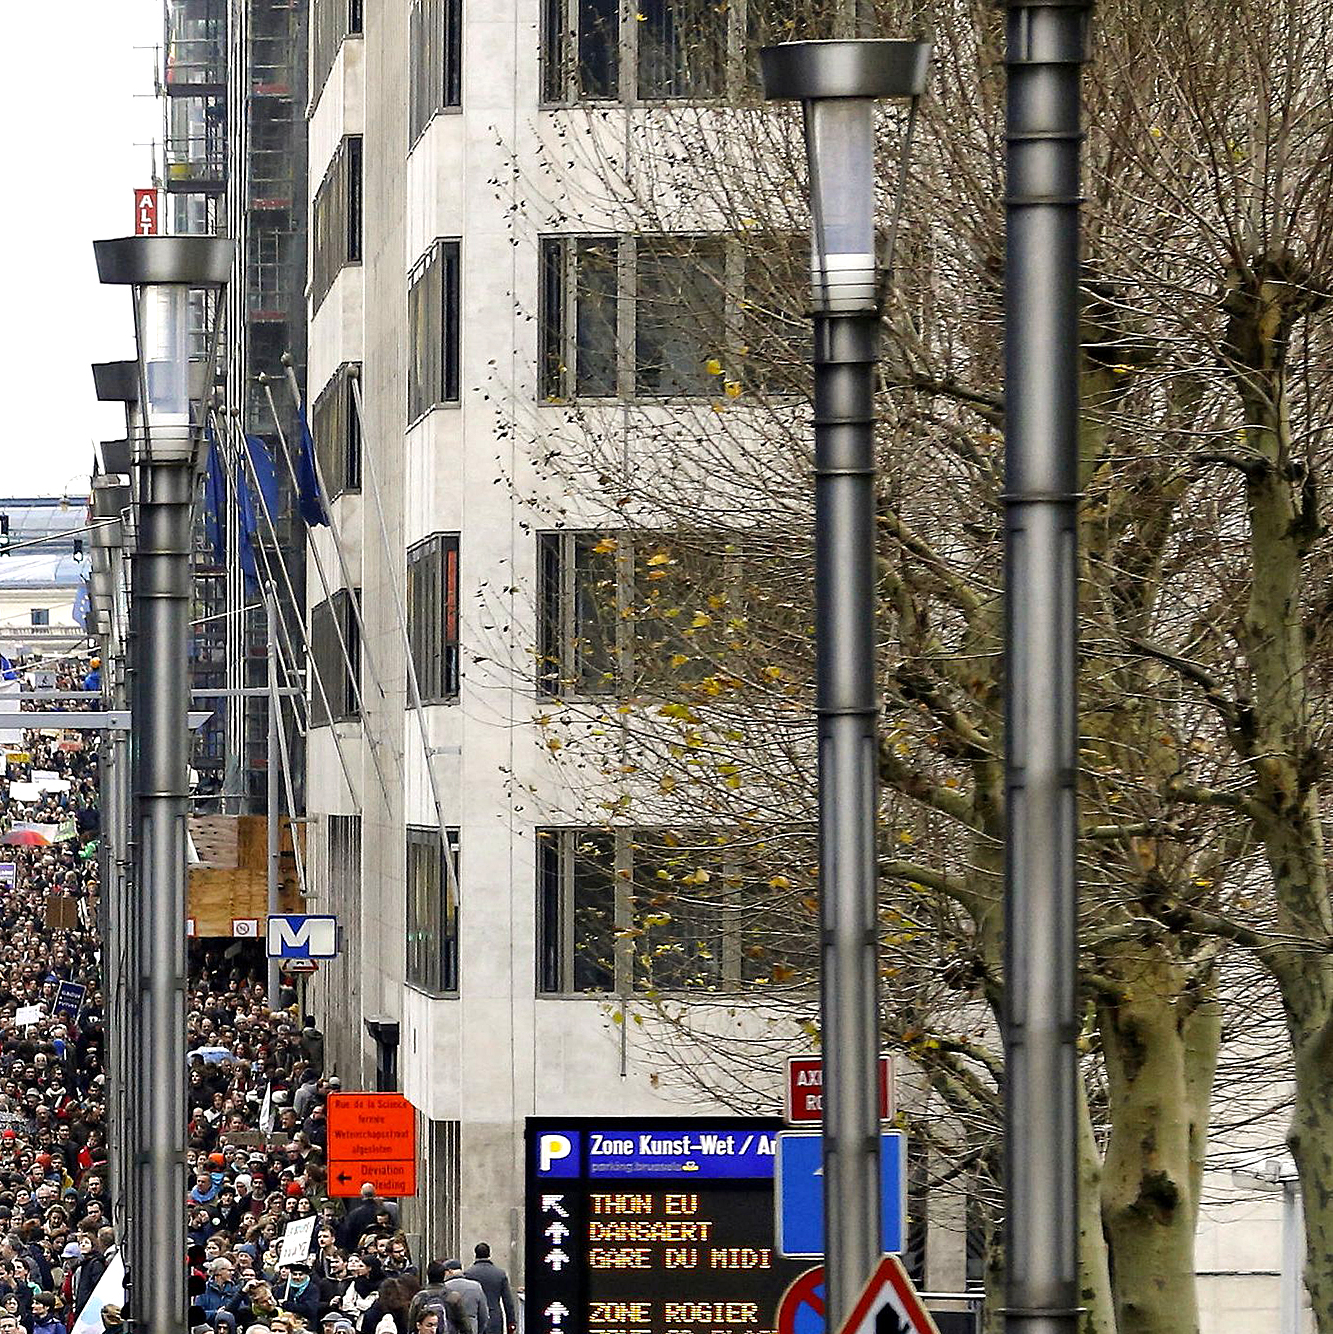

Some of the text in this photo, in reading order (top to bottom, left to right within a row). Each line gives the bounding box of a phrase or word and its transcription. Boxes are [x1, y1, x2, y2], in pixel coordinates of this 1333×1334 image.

[797, 1070, 823, 1086] AX
[334, 1100, 407, 1109] Rue de la Science
[539, 1134, 572, 1171] P
[590, 1135, 634, 1155] Zone
[639, 1134, 735, 1156] Kunst-Wet
[589, 1194, 698, 1215] THON EU
[589, 1221, 713, 1242] DANSAERT
[589, 1248, 772, 1269] GARE DU MIDI
[589, 1302, 758, 1323] ZONE ROGIER
